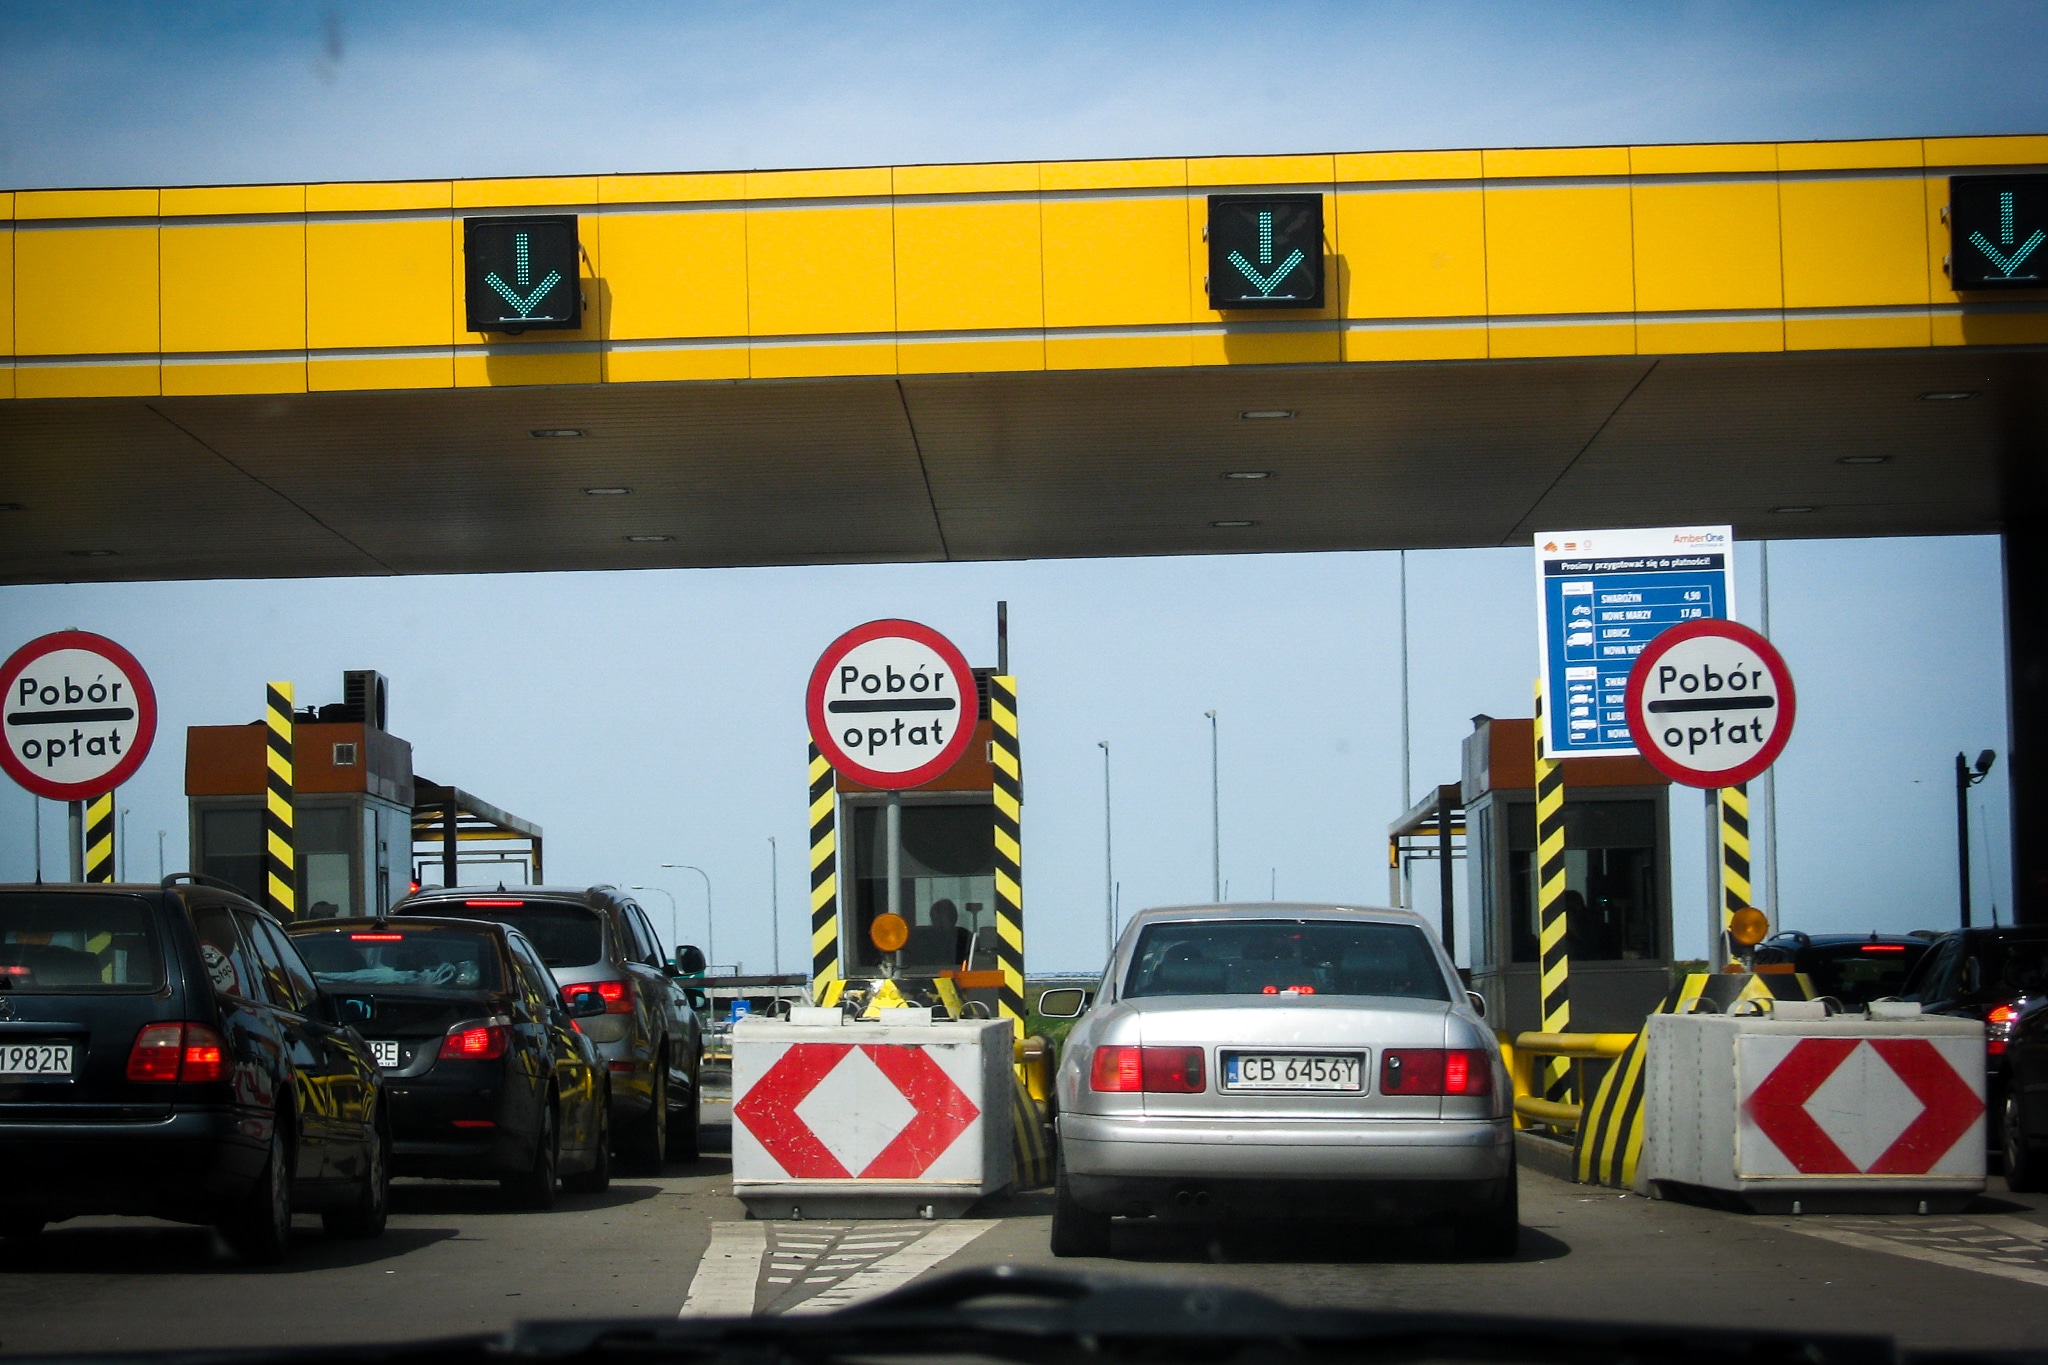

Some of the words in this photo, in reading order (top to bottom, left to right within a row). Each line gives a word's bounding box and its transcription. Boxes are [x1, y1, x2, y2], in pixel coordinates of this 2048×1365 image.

[1673, 533, 1724, 543] AmberOne
[1561, 562, 1593, 571] Prosimy
[1594, 559, 1645, 571] przygotować
[1646, 559, 1658, 568] się
[1659, 558, 1670, 567] do
[1601, 591, 1642, 604] SWAROŻYN
[1602, 611, 1625, 621] NOWE
[1625, 610, 1652, 620] MARZY
[1602, 628, 1630, 638] LUBICZ
[1603, 645, 1626, 656] NOWA
[841, 664, 944, 694] Pobór
[1659, 662, 1762, 694] Pobór
[19, 674, 122, 706] Pobór
[843, 718, 944, 756] opłat
[1607, 728, 1631, 739] NOWA
[1664, 716, 1763, 755] opłat
[21, 728, 122, 767] opłat
[1243, 1058, 1276, 1081] CB
[1285, 1057, 1356, 1082] 6456Y
